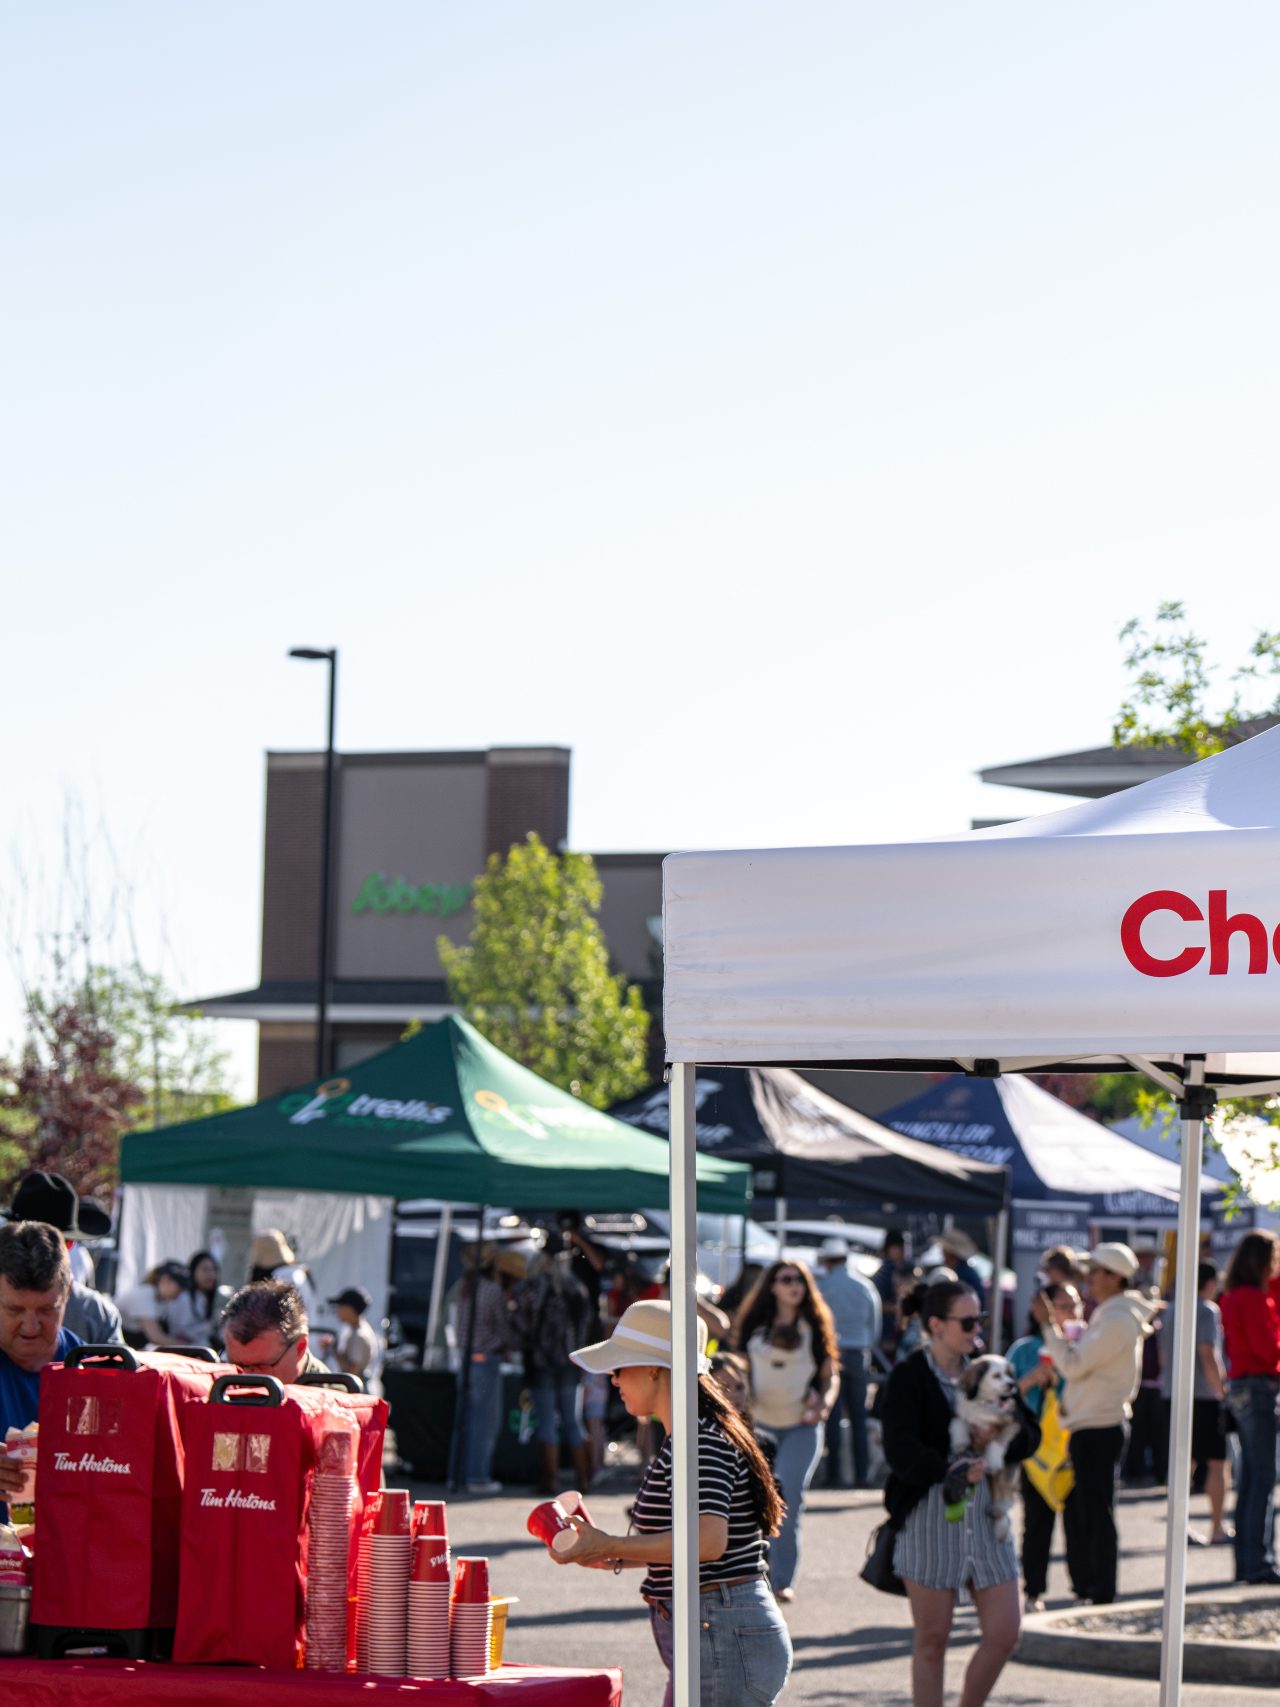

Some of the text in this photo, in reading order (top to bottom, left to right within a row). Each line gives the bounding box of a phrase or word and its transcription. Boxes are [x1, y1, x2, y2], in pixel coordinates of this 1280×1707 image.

[54, 1452, 131, 1474] Tim Hortons
[200, 1488, 276, 1511] Tim Hortons
